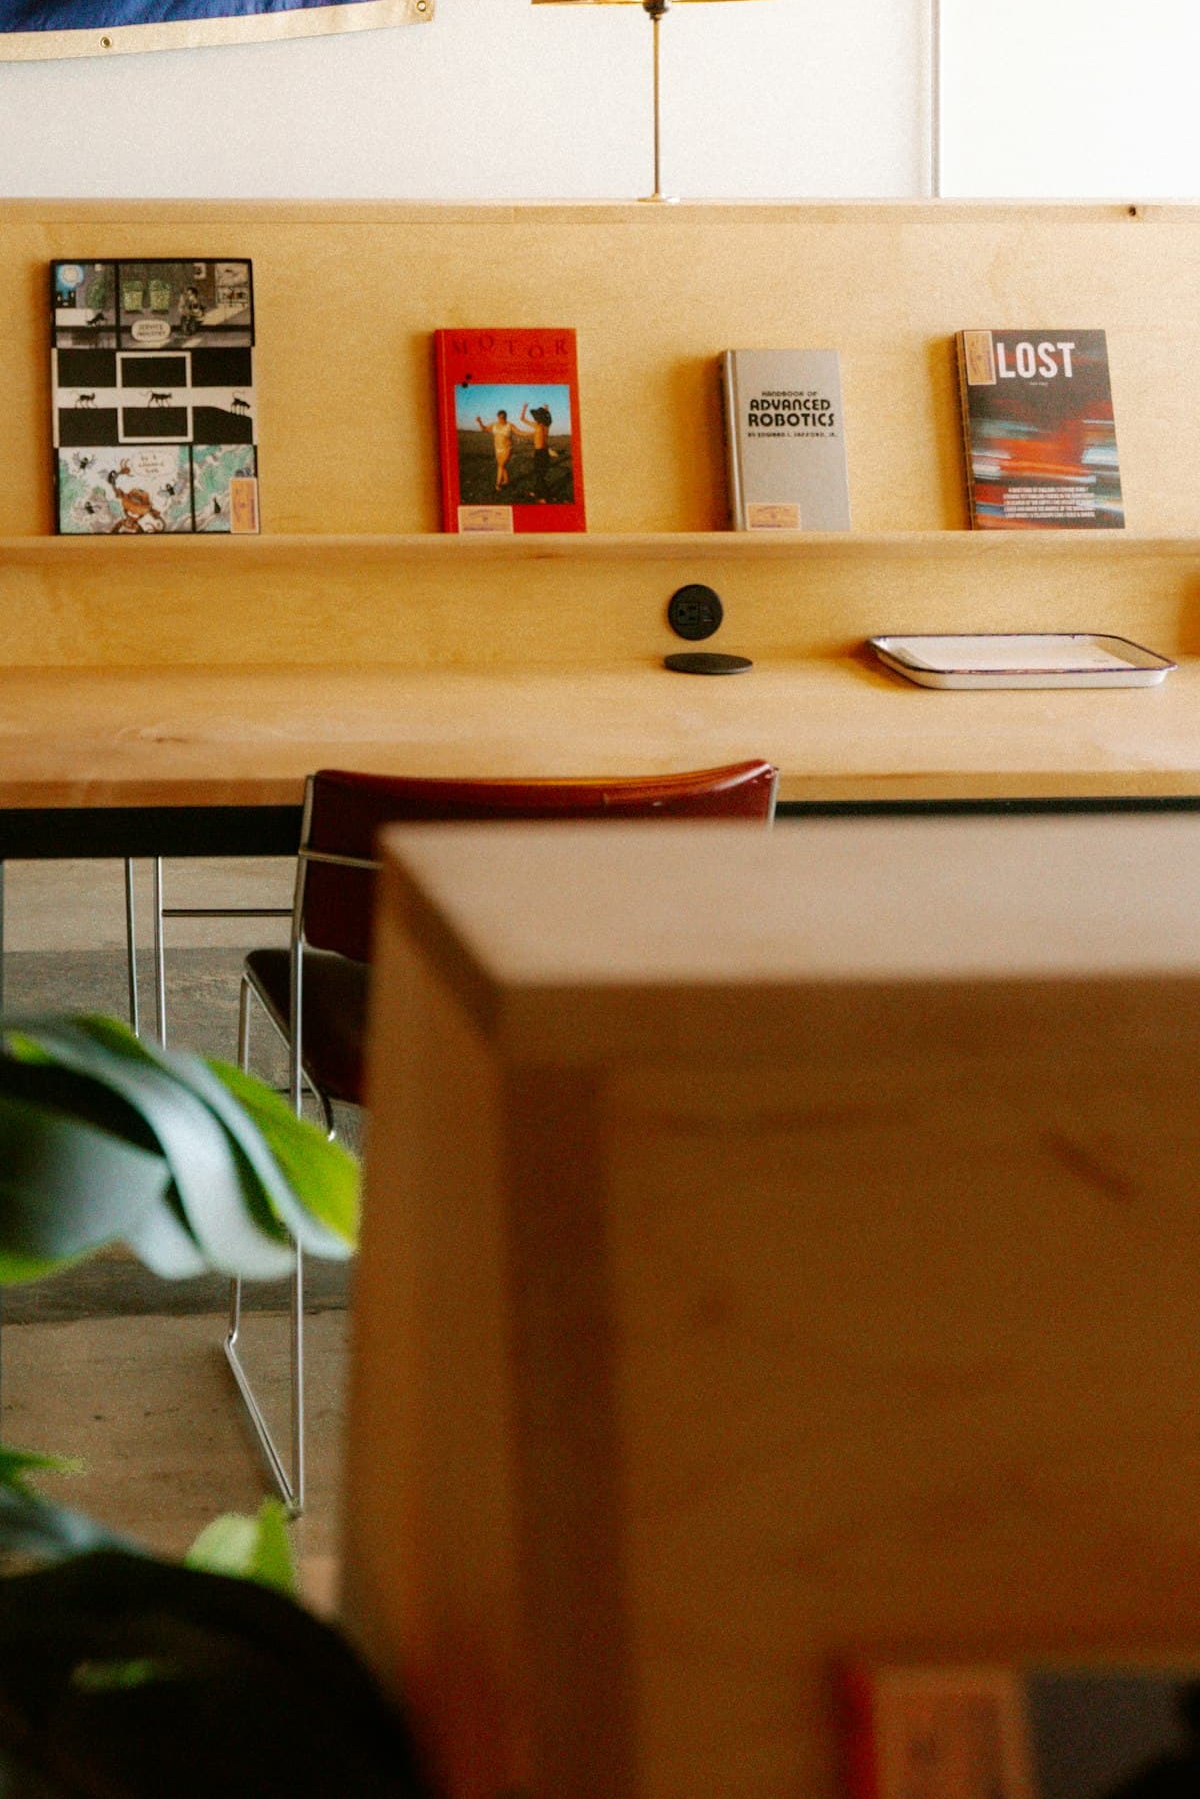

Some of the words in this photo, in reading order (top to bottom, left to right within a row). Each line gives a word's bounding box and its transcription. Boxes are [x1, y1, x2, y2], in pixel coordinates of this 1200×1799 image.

[996, 342, 1076, 378] LOST
[750, 398, 831, 411] ADVANCED
[748, 413, 835, 427] ROBOTICS
